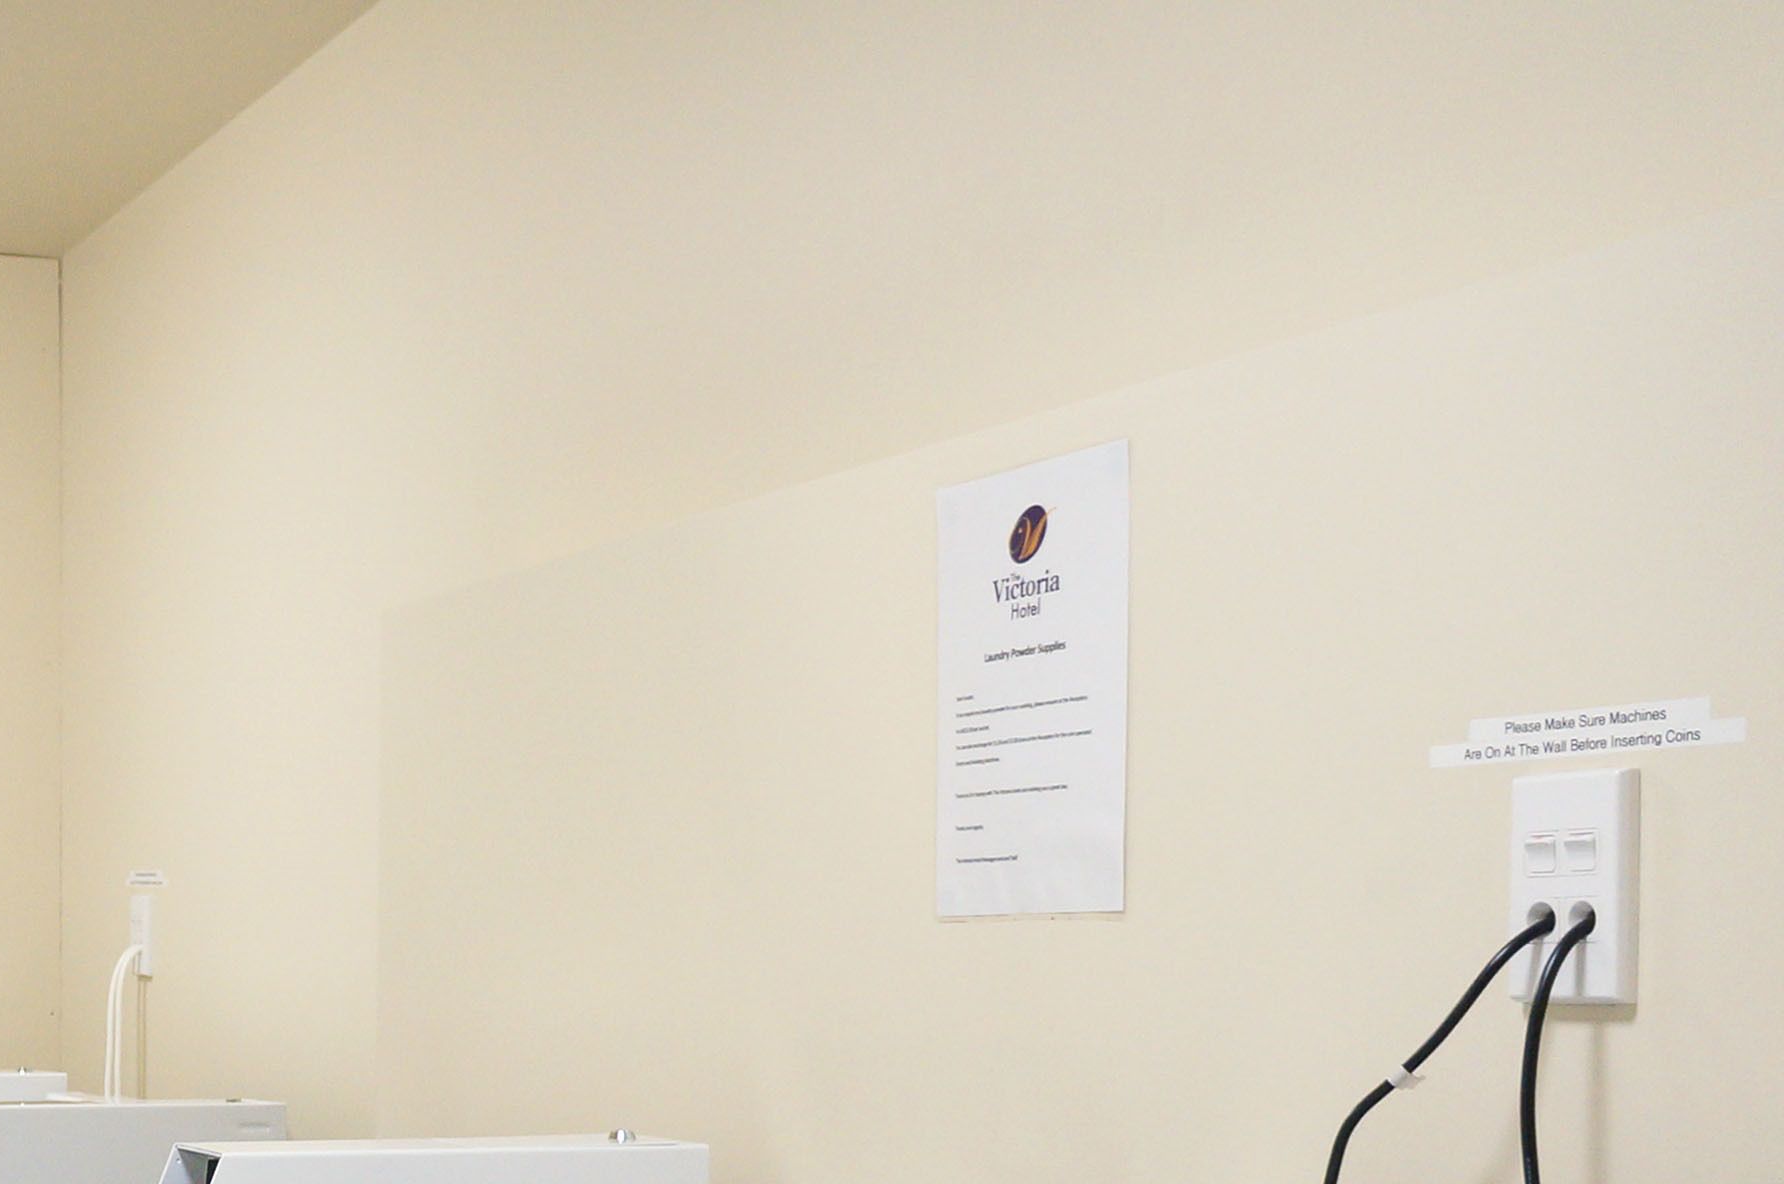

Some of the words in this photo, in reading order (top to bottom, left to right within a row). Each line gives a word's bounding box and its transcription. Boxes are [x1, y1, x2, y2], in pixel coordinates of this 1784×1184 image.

[992, 569, 1060, 603] Victoria
[1011, 597, 1041, 620] Hotel
[984, 650, 1009, 662] Laundry
[1011, 646, 1036, 658] Powder
[1038, 641, 1066, 653] Supplies
[1504, 721, 1541, 734] Please
[1544, 718, 1575, 731] Make
[1578, 714, 1606, 728] Sure
[1609, 708, 1667, 725] Machines
[1464, 749, 1482, 760] Are
[1485, 746, 1501, 759] On
[1504, 745, 1516, 757] At
[1519, 743, 1539, 756] The
[1542, 740, 1567, 754] Wall
[1570, 738, 1608, 752] Before
[1611, 731, 1662, 748] Inserting
[1666, 728, 1701, 743] Coins
